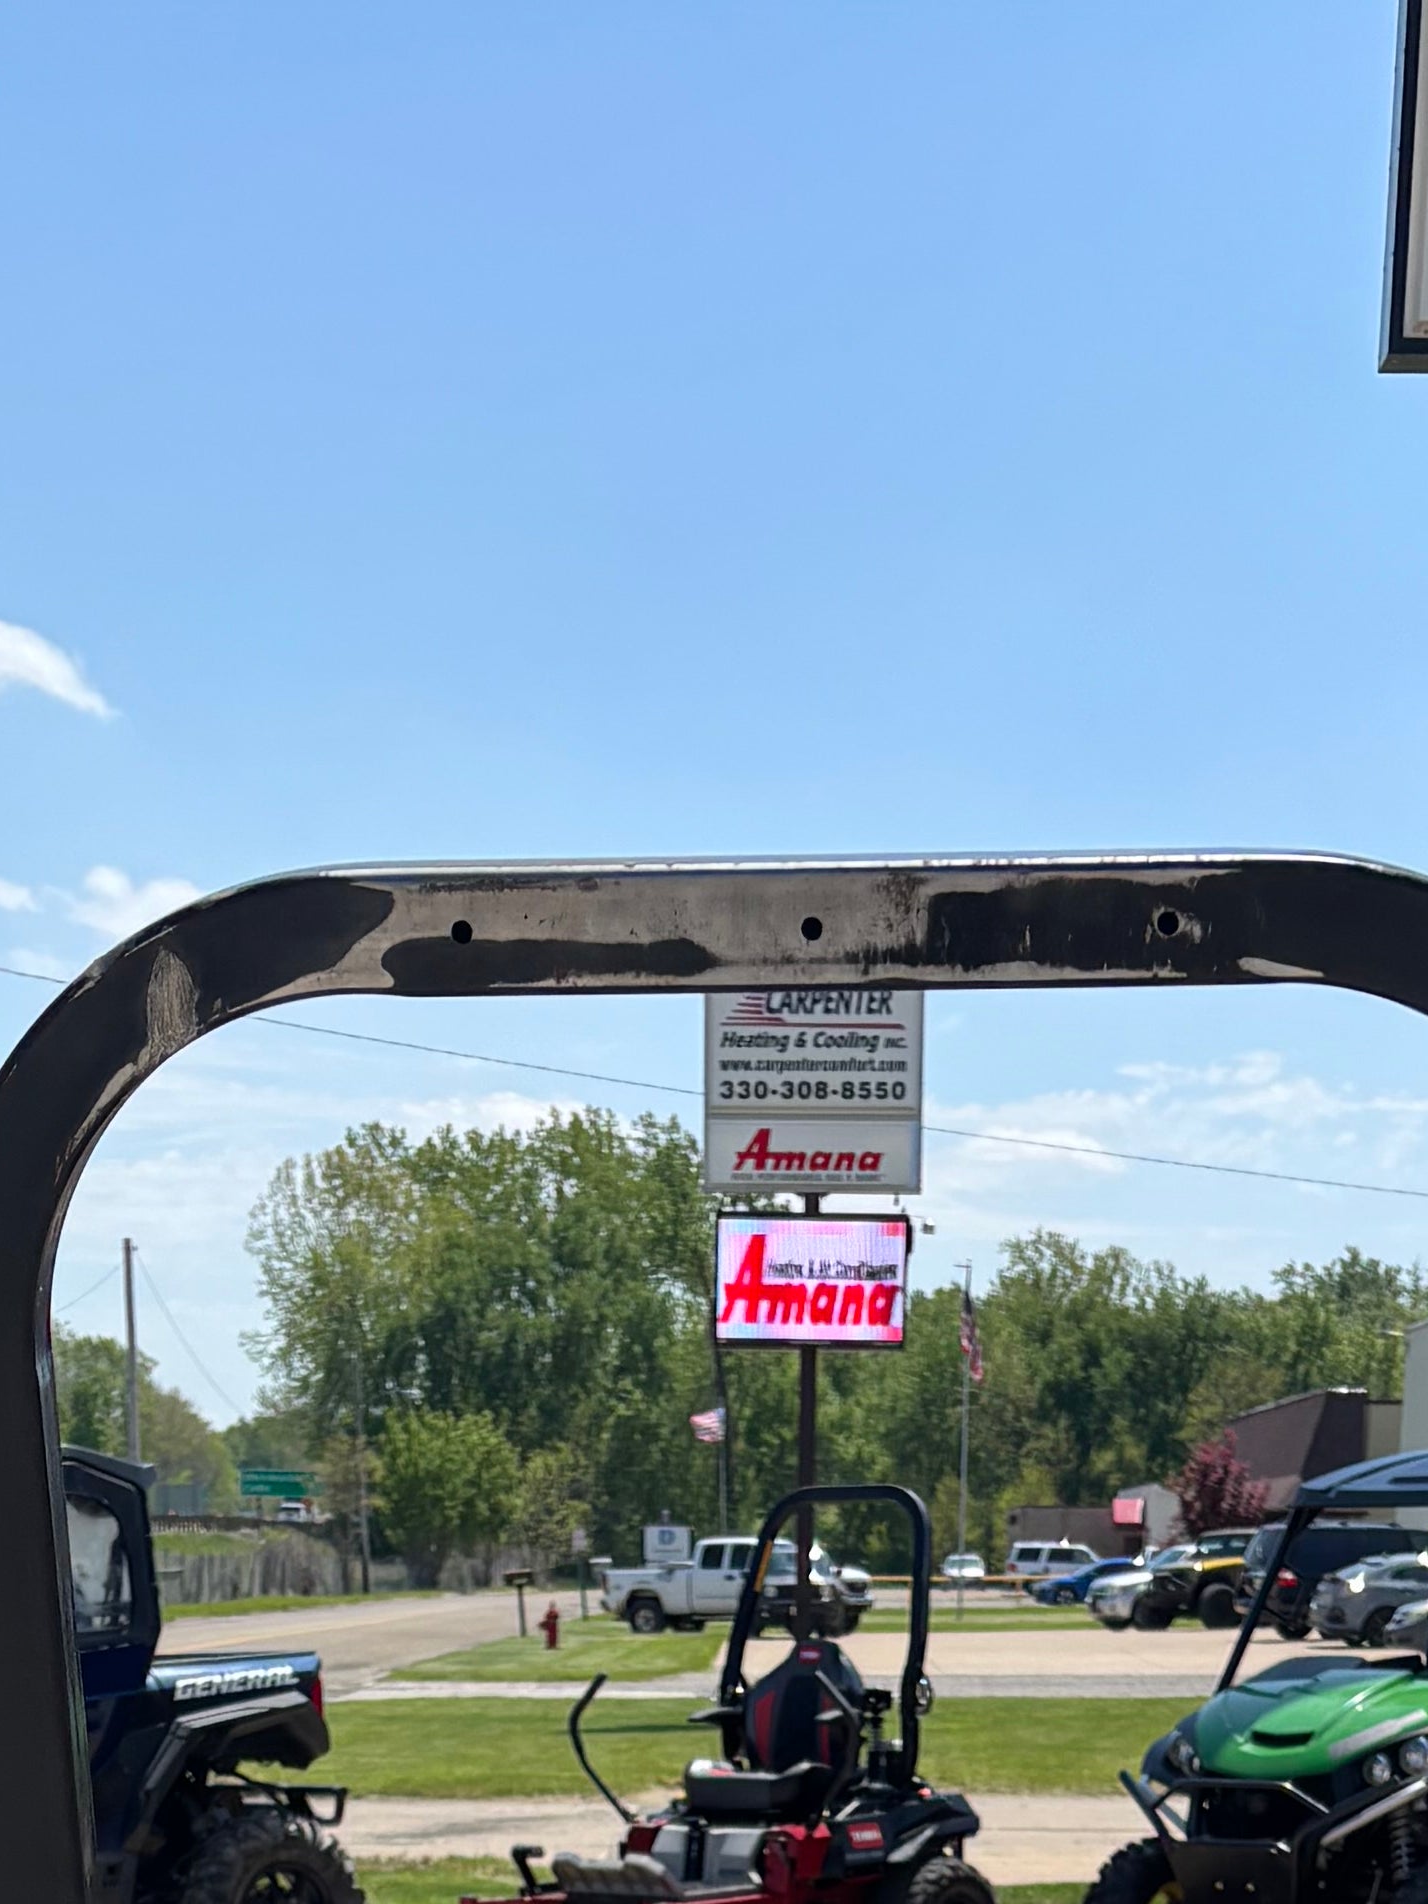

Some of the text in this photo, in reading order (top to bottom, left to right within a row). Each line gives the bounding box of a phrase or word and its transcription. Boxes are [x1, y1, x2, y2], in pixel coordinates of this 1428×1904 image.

[766, 992, 892, 1015] CARPENTER
[721, 1032, 790, 1053] Heating
[794, 1031, 807, 1048] &
[813, 1032, 880, 1053] Cooling
[720, 1080, 906, 1100] 330-308-8550
[733, 1128, 884, 1171] Amana
[716, 1234, 901, 1326] Amana
[173, 1666, 300, 1701] GENERAL
